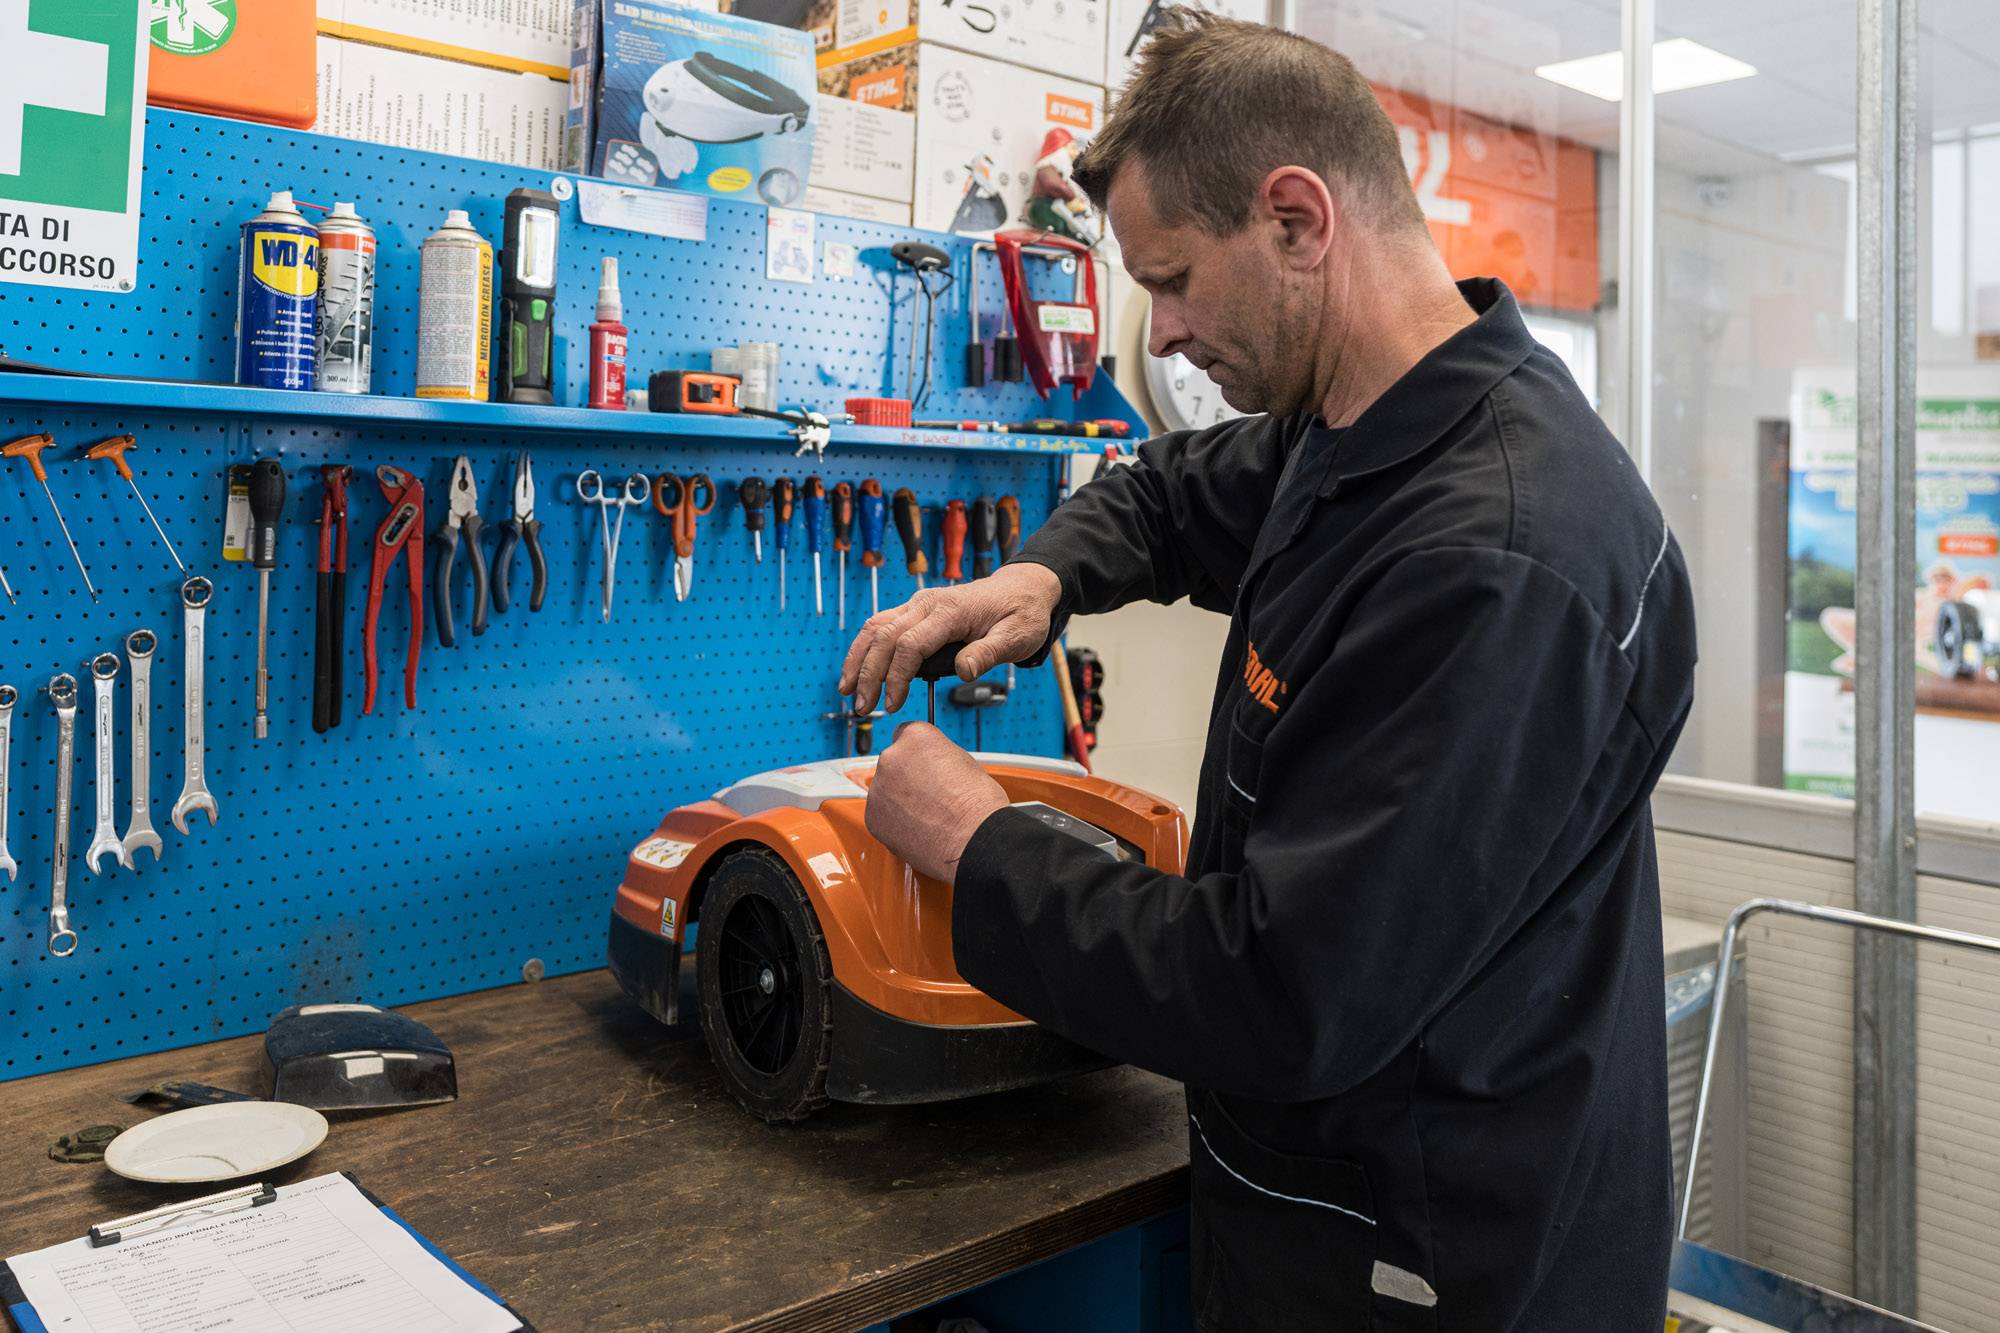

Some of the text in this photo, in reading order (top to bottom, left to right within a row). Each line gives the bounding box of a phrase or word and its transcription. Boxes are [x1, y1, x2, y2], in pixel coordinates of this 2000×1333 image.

[856, 77, 898, 102] STIHL
[1051, 101, 1089, 121] STIHL
[42, 217, 69, 242] DI
[0, 247, 115, 280] CCORSO
[481, 265, 492, 301] GREASE
[479, 304, 490, 361] MICROFLON
[1192, 396, 1202, 415] 7
[1244, 640, 1279, 713] TIHL
[118, 1236, 173, 1254] TAGLIANDO
[174, 1221, 227, 1240] INVERNALE
[229, 1214, 256, 1225] SERIE
[303, 1278, 366, 1300] DESCRIZIONE
